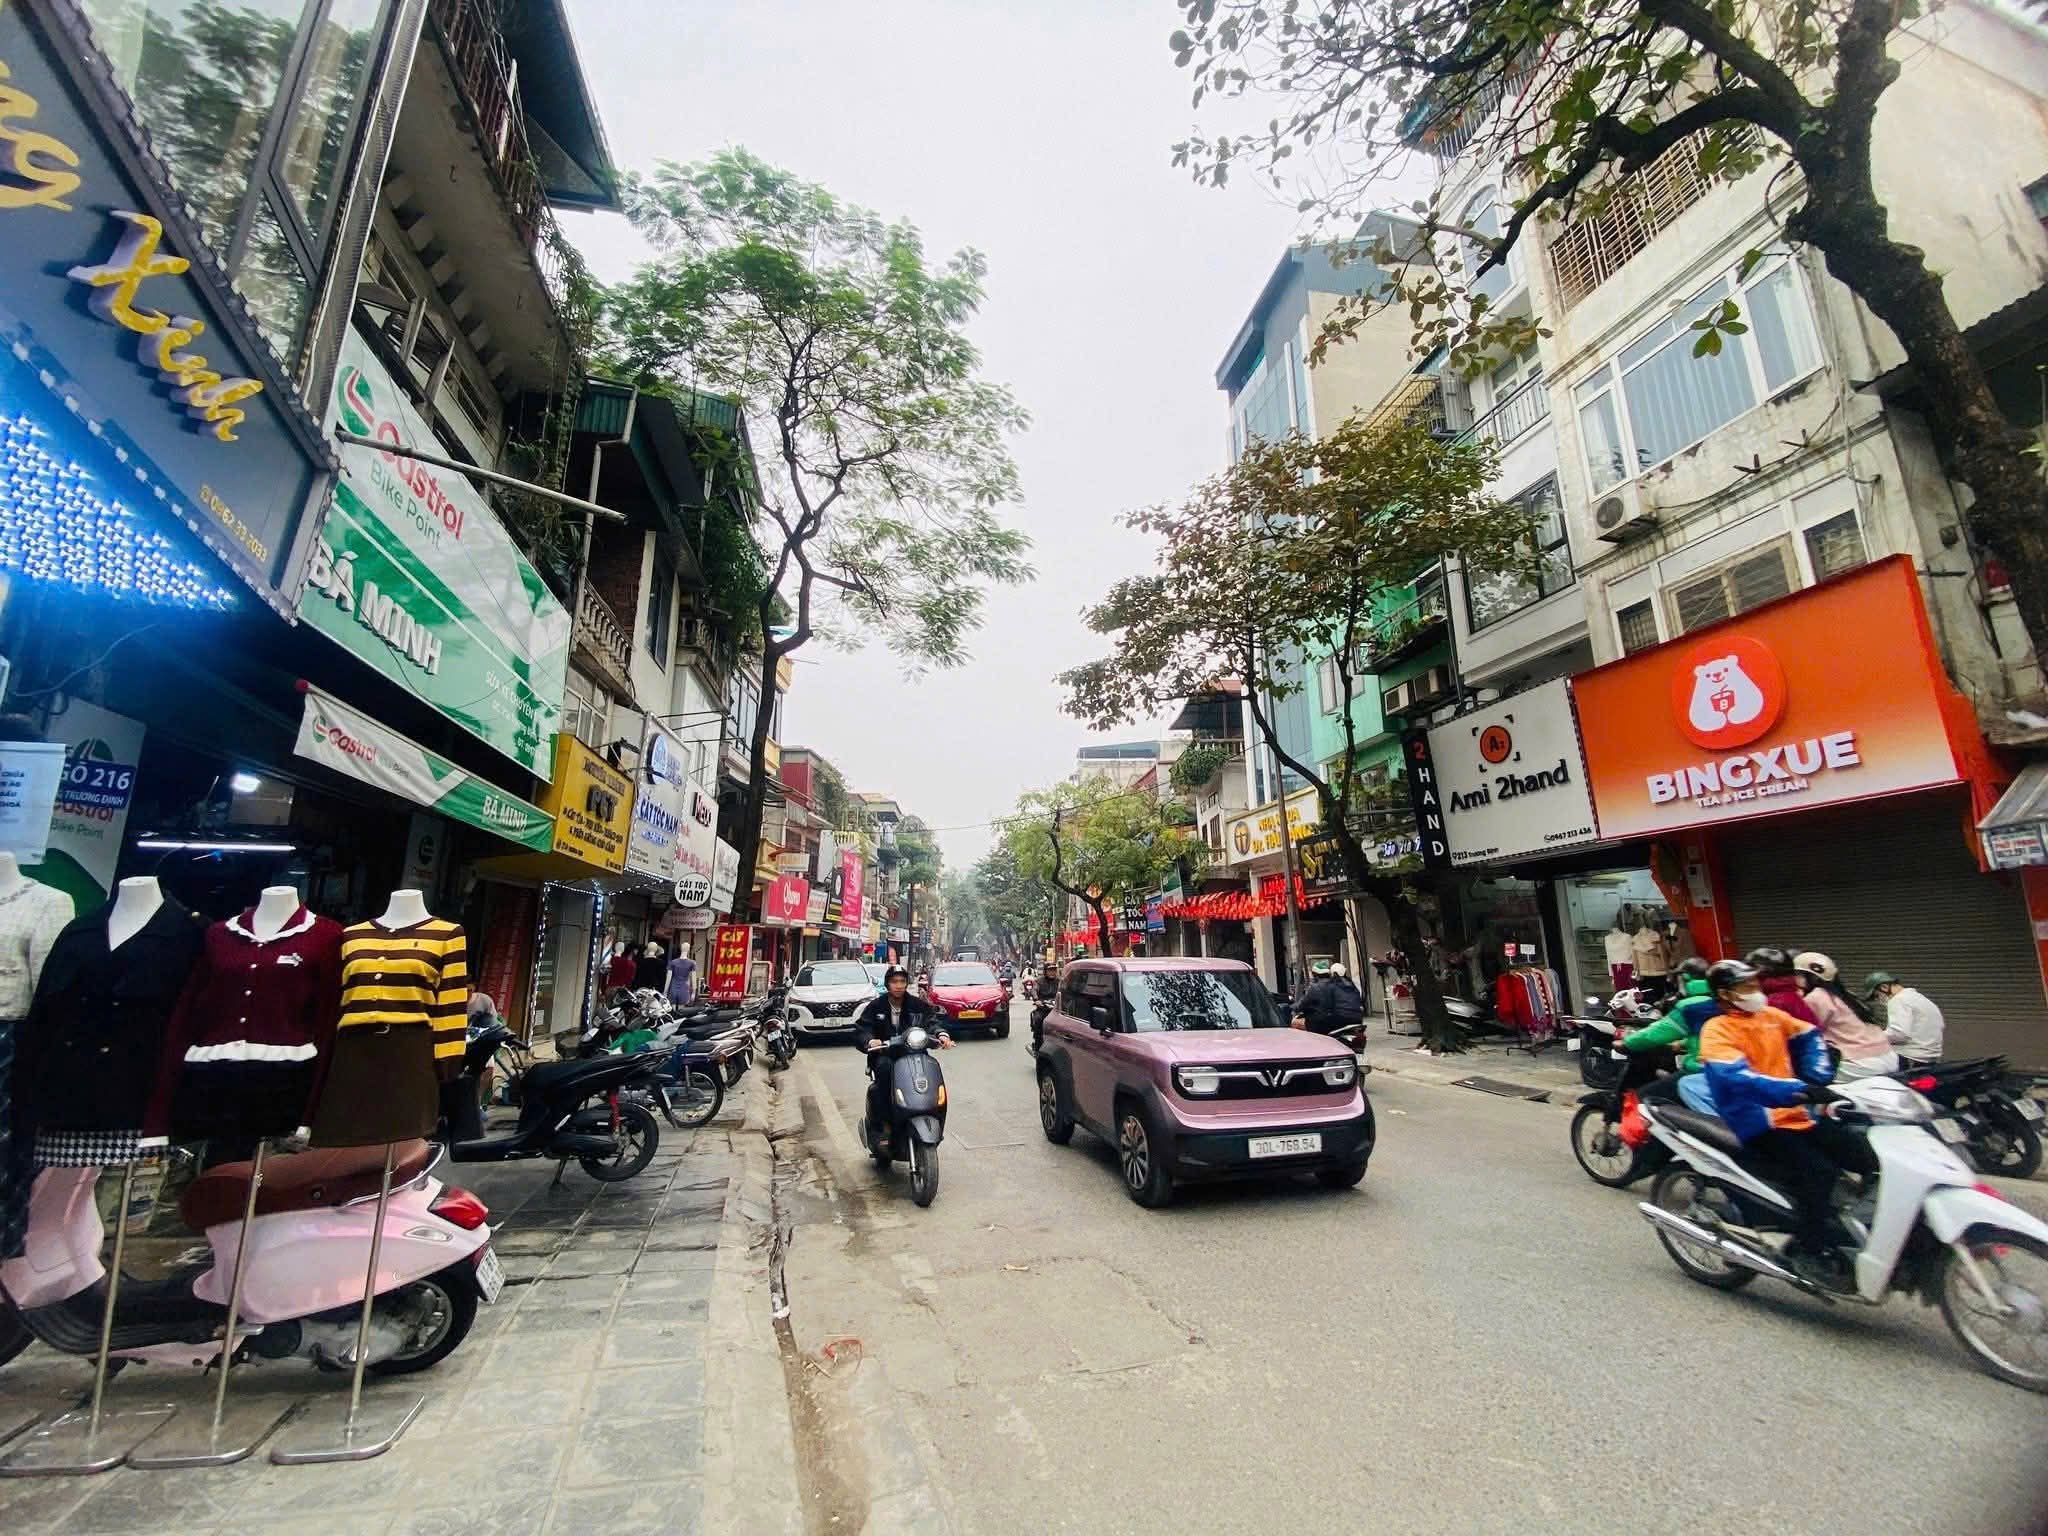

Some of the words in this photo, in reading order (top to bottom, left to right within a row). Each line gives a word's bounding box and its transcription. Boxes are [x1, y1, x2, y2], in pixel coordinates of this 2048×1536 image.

[370, 461, 403, 510] Bike
[406, 498, 442, 551] Point
[308, 536, 358, 613] BÁ
[359, 580, 442, 676] MINH
[90, 767, 131, 790] 216
[1646, 730, 1862, 804] BINGXUE
[1450, 783, 1491, 815] Ami
[1495, 758, 1570, 801] 2hand
[1695, 795, 1721, 808] TEA
[1733, 788, 1755, 801] ICE
[1758, 778, 1809, 799] CREAM
[500, 803, 528, 833] MINH
[679, 889, 705, 901] NAM
[1128, 920, 1147, 930] NAM
[716, 963, 744, 975] NAM
